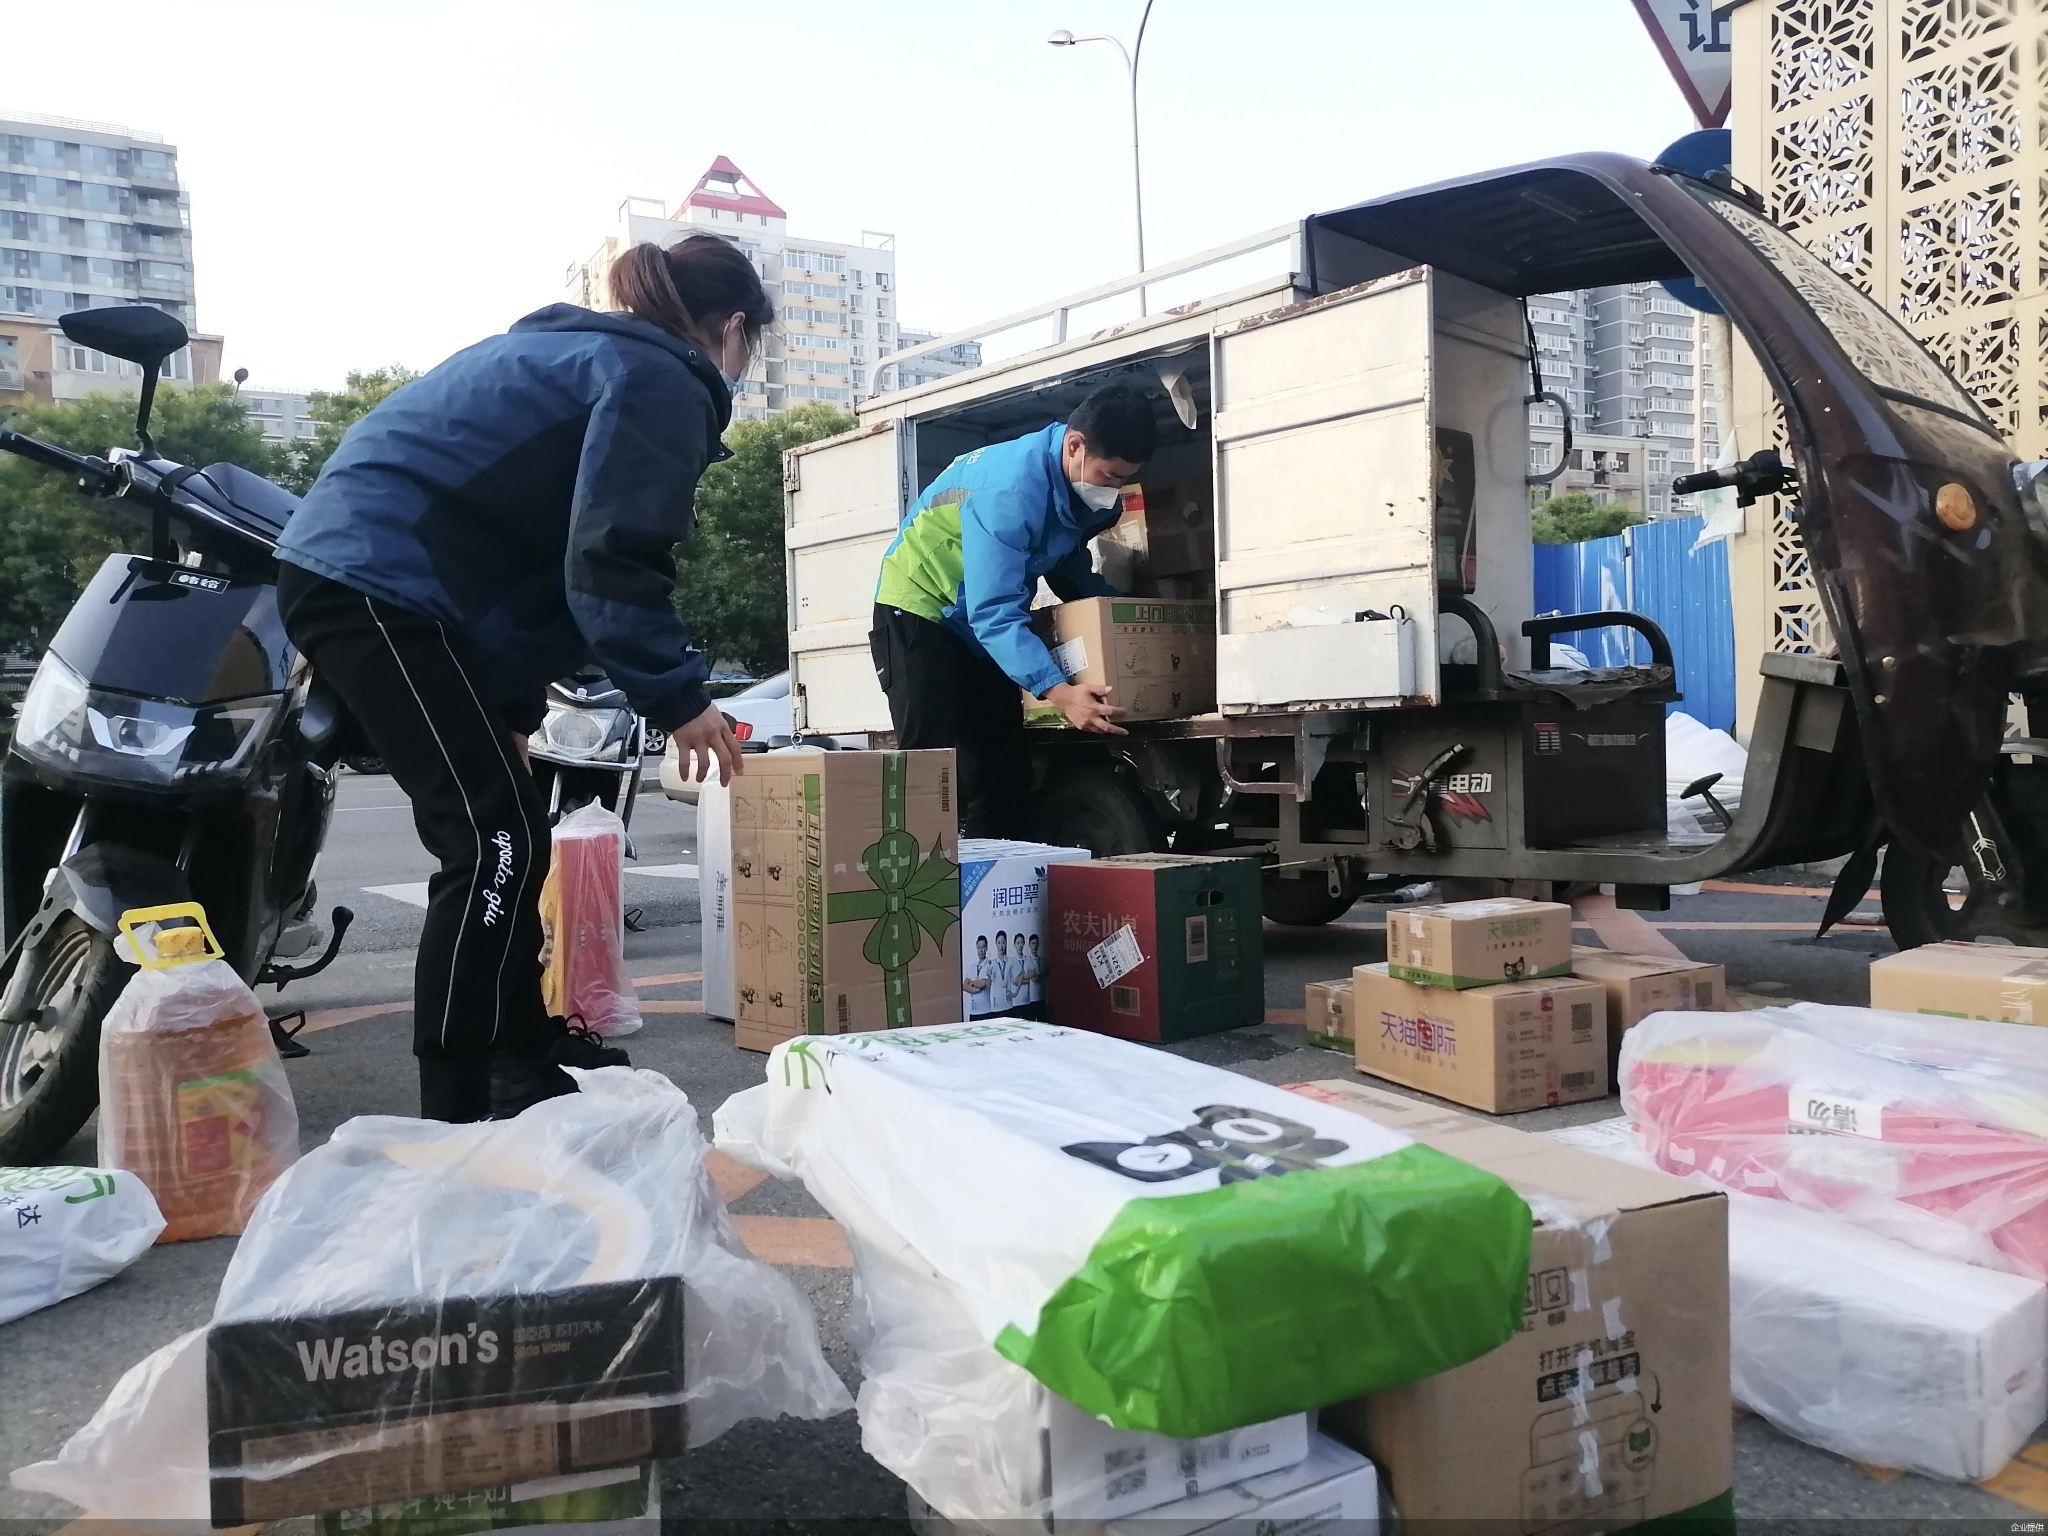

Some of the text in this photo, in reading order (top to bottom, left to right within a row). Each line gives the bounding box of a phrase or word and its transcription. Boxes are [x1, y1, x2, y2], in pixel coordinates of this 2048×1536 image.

[992, 883, 1039, 909] 润田翠
[296, 1322, 499, 1382] Watson's
